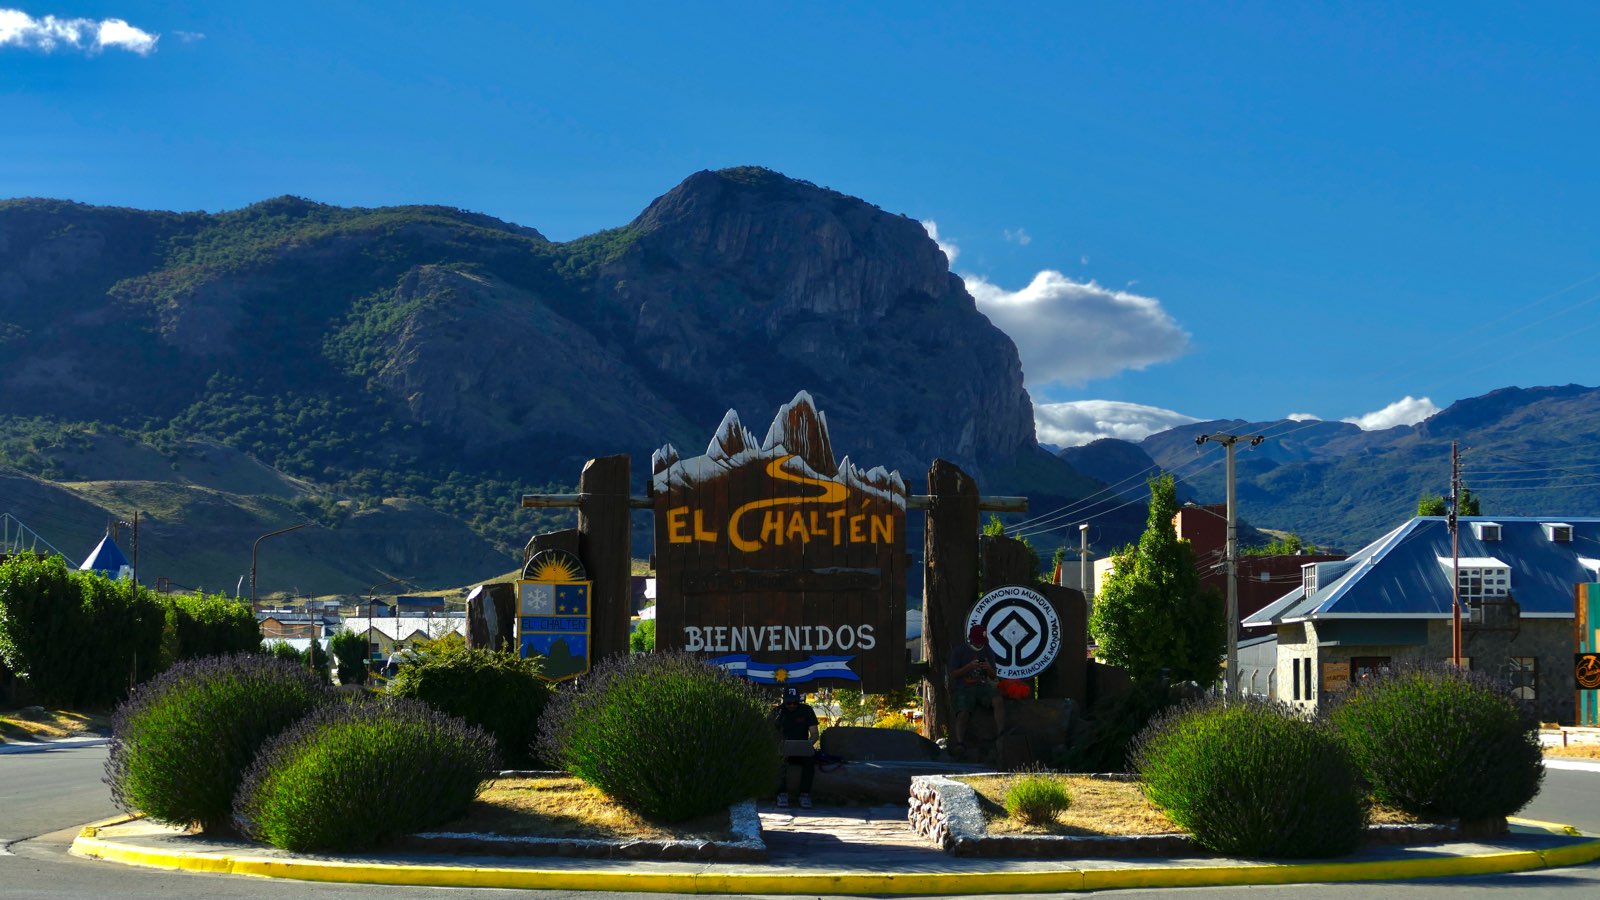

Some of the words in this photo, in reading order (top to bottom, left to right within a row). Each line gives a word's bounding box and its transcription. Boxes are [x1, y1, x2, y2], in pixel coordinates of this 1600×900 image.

[666, 505, 718, 543] EL
[728, 498, 895, 552] CHALTÉN
[976, 588, 1020, 614] PATRIMONIO
[1021, 590, 1052, 616] MUNDIAL
[521, 618, 534, 629] EL
[683, 624, 876, 652] BIENVENIDOS
[1008, 654, 1051, 677] PATRIMOINE
[1049, 618, 1060, 657] MONDIAL
